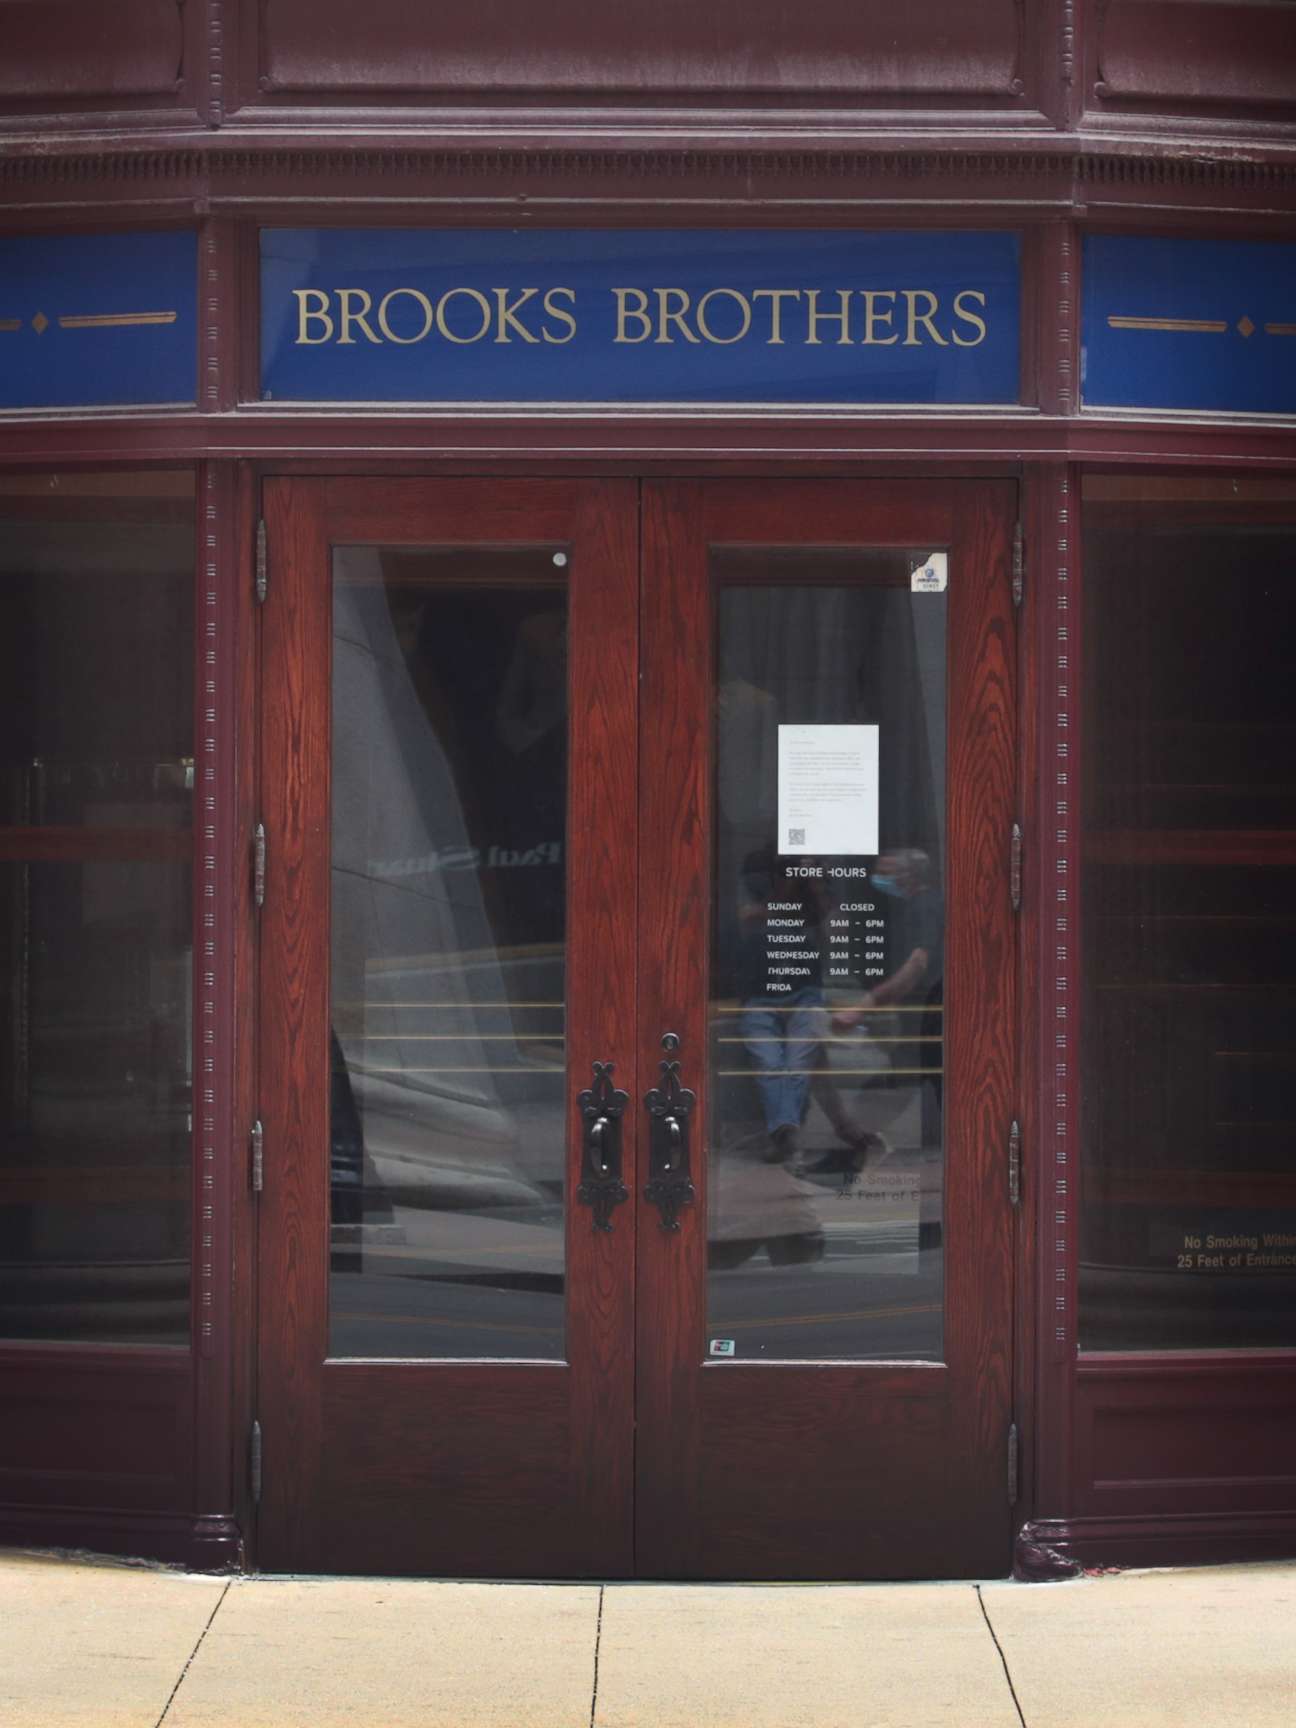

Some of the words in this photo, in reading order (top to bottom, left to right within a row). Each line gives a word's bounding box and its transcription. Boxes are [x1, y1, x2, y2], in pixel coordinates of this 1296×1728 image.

[293, 287, 576, 344] BROOKS
[611, 288, 987, 347] BROTHERS
[785, 866, 823, 878] STORE
[767, 902, 802, 911] SUNDAY
[839, 903, 875, 912] CLOSED
[766, 918, 805, 927] MONDAY
[829, 919, 849, 928] 9AM
[865, 919, 884, 928] 6PM
[767, 934, 806, 943] TUESDAY
[829, 935, 849, 944] 9AM
[865, 935, 884, 944] 6PM
[766, 950, 820, 960] WEDNESDAY
[829, 951, 849, 960] 9AM
[865, 951, 884, 960] 6PM
[829, 967, 849, 976] 9AM
[865, 967, 884, 976] 6PM
[1184, 1235, 1201, 1249] No
[1206, 1234, 1258, 1249] Smoking
[1177, 1254, 1193, 1268] 25
[1196, 1254, 1225, 1268] Feet
[1230, 1253, 1242, 1267] of
